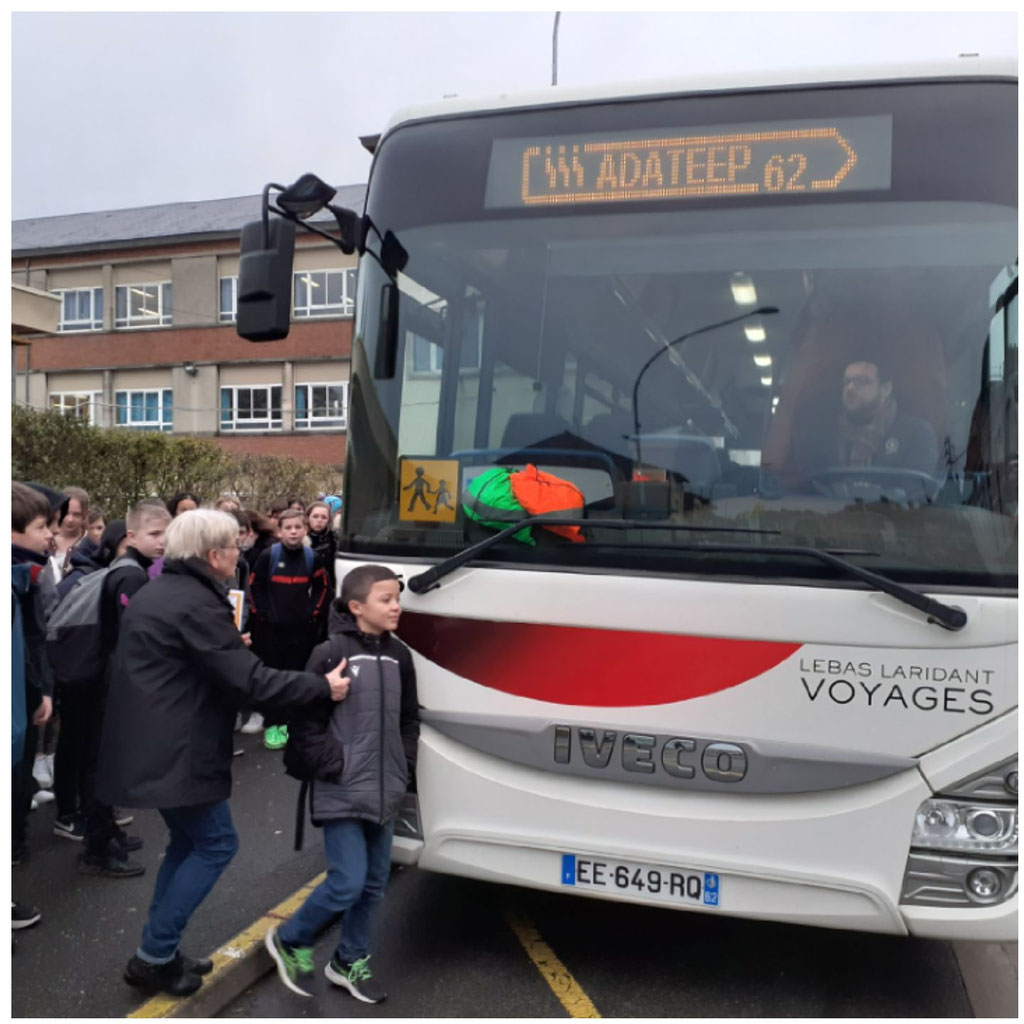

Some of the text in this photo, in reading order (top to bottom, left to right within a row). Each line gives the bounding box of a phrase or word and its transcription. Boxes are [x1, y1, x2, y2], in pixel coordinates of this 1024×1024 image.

[596, 144, 807, 191] ADATEEP 62
[800, 658, 994, 685] LEBAS LARIDANT
[801, 677, 994, 715] VOYAGES
[553, 725, 748, 783] IVECO
[576, 860, 701, 900] EE-649-RQ
